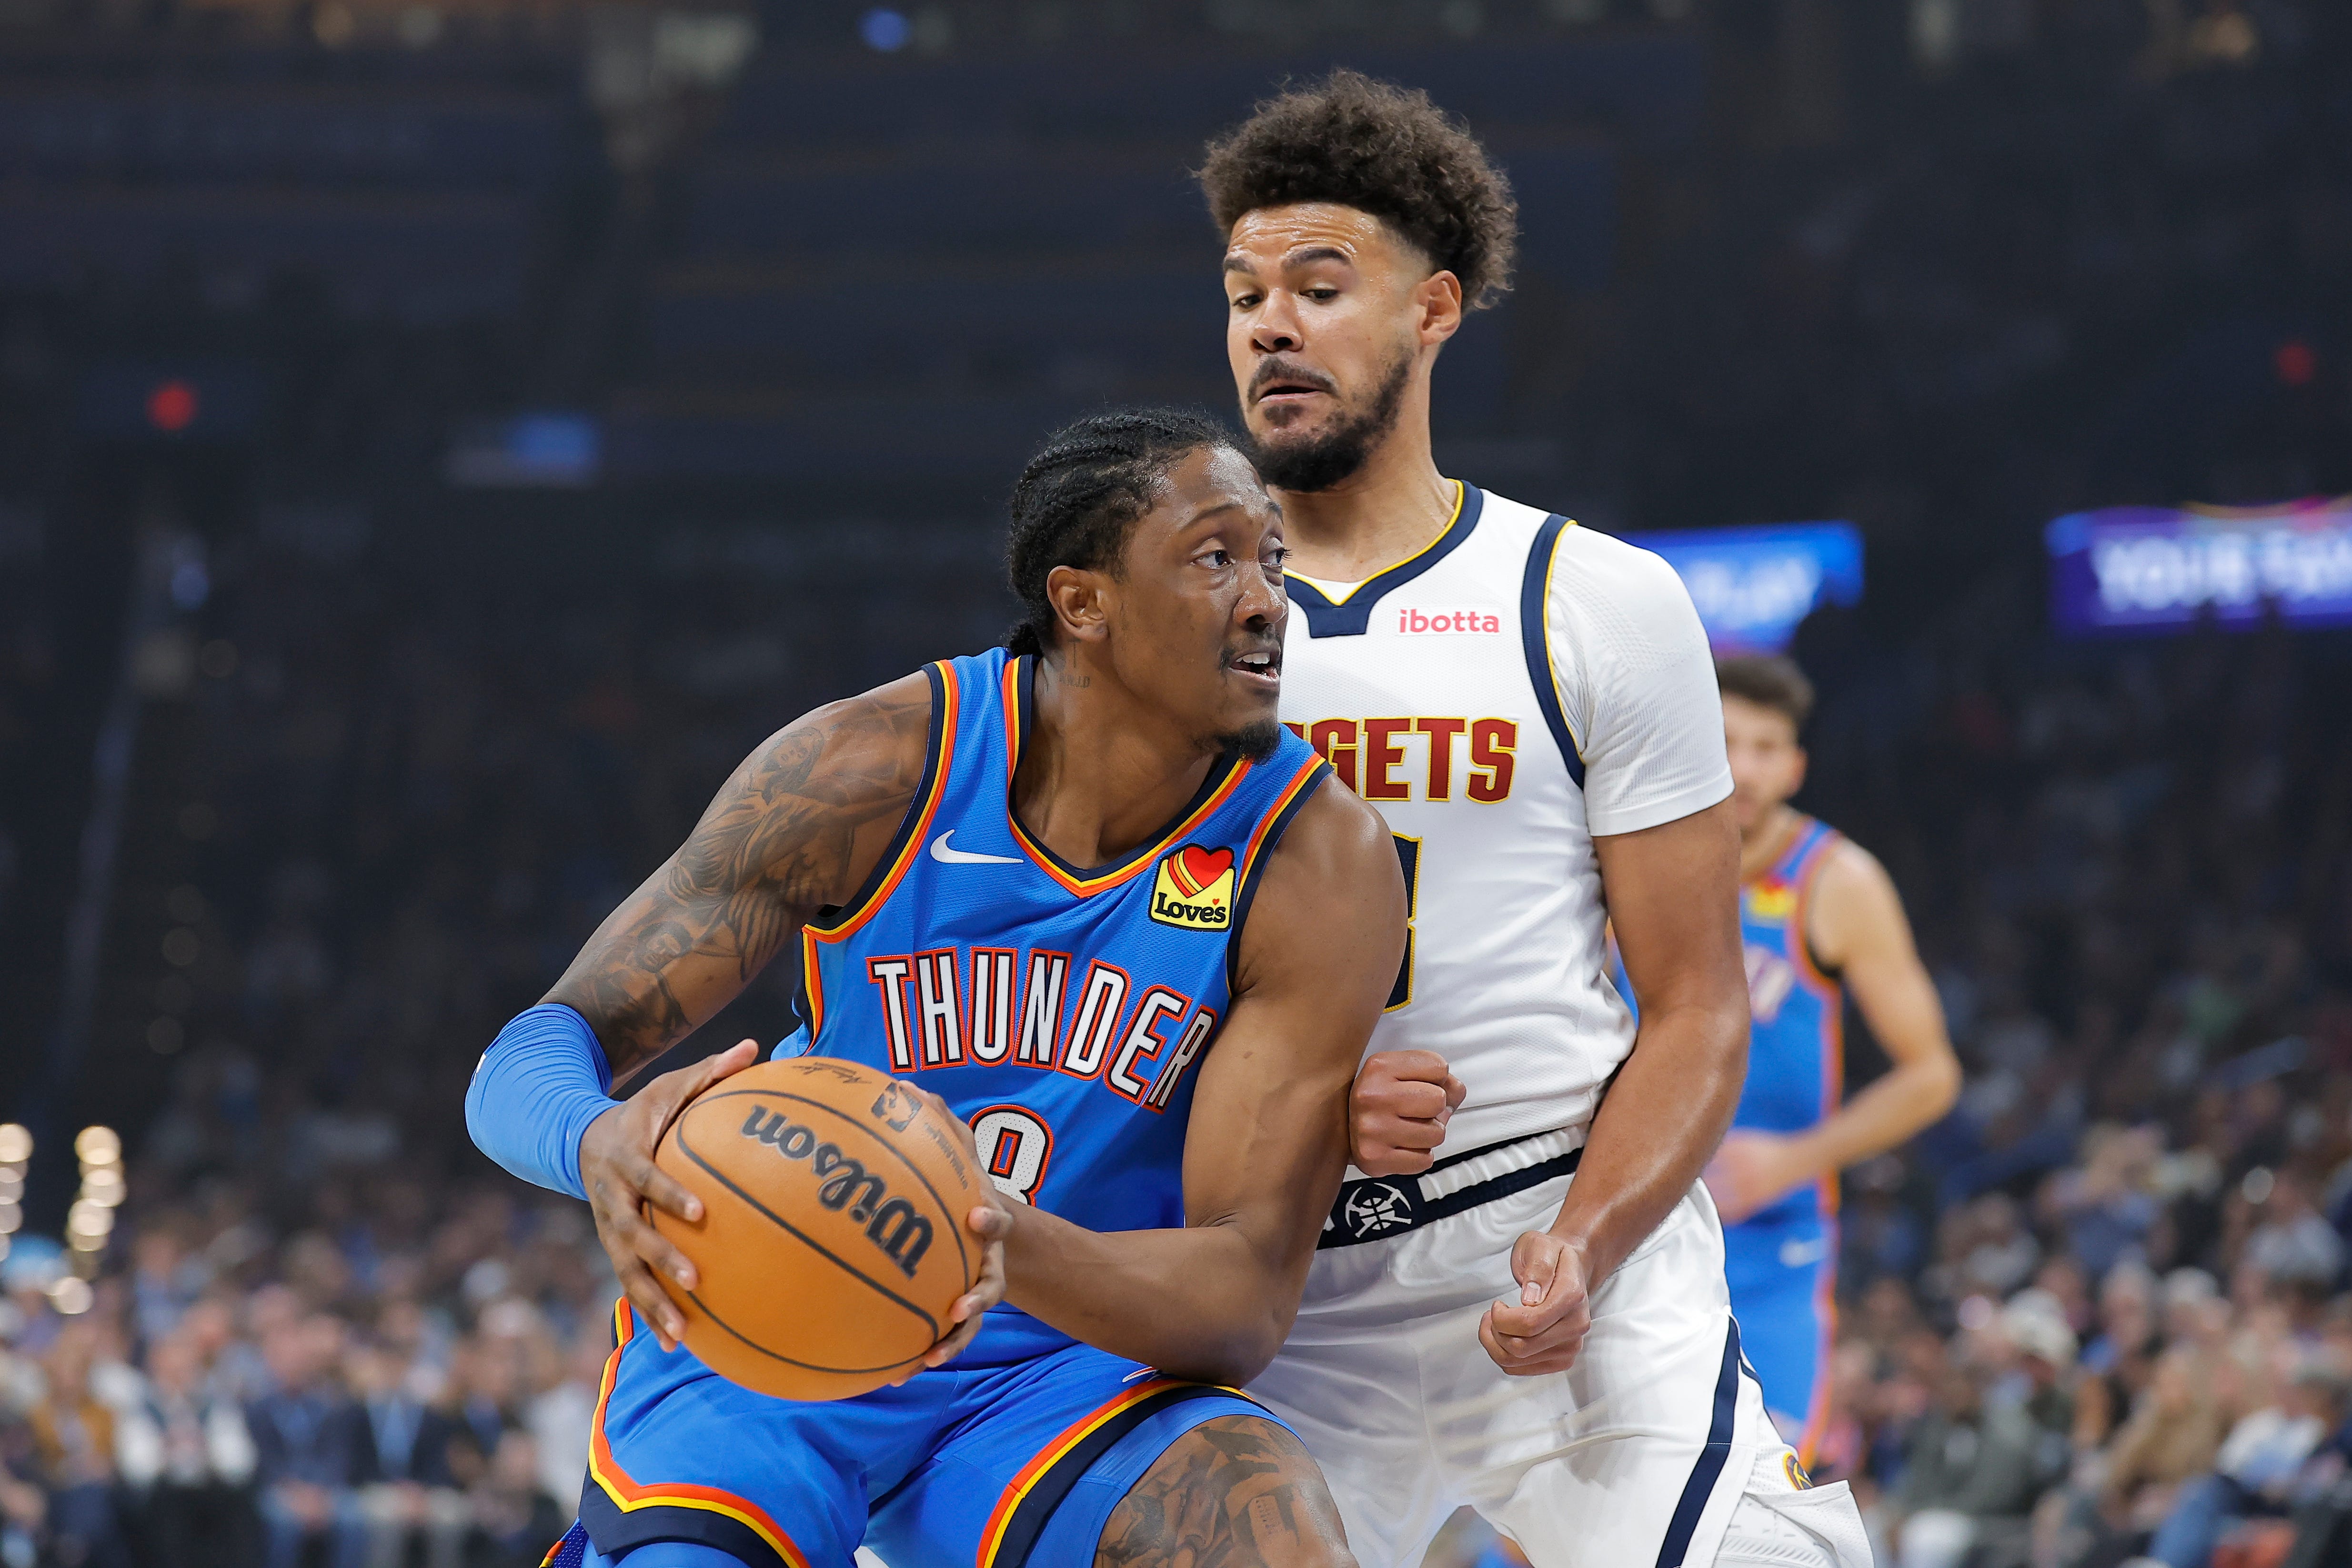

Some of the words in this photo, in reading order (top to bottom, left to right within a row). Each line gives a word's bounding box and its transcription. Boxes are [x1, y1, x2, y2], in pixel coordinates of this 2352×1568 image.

[1399, 608, 1500, 634] ibotta
[1279, 716, 1519, 804] GETS
[865, 946, 1218, 1115] THUNDER
[739, 1104, 934, 1281] Wilson
